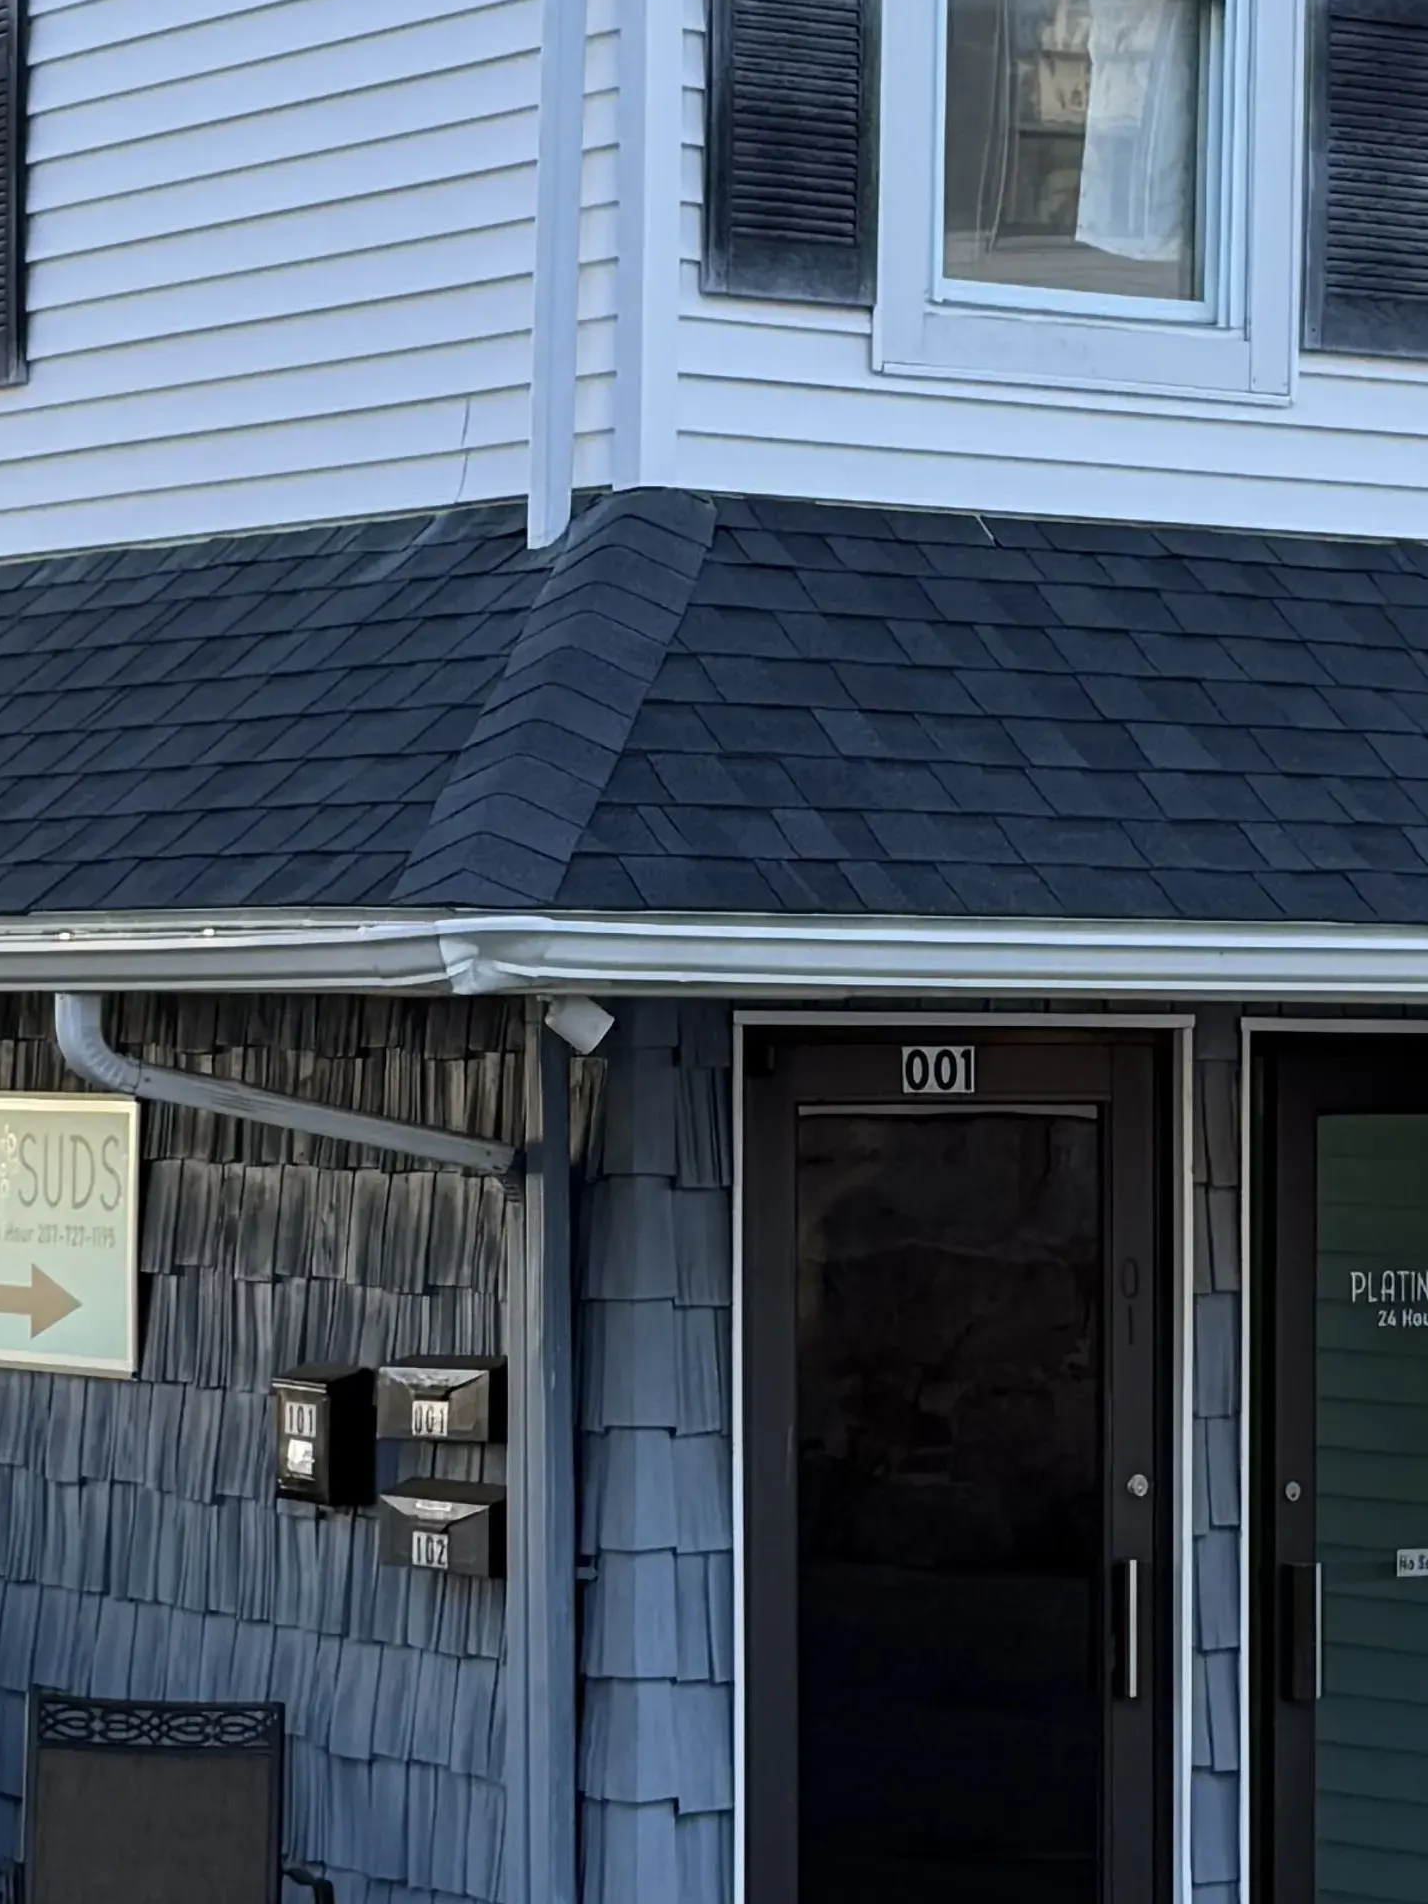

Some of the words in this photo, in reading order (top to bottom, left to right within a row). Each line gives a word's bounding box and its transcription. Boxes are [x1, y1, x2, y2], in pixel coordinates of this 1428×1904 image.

[905, 1049, 972, 1090] 001
[18, 1133, 122, 1212] SUDS
[1378, 1310, 1396, 1326] 24
[288, 1405, 314, 1435] 101
[414, 1405, 447, 1435] 001
[416, 1536, 447, 1566] 102
